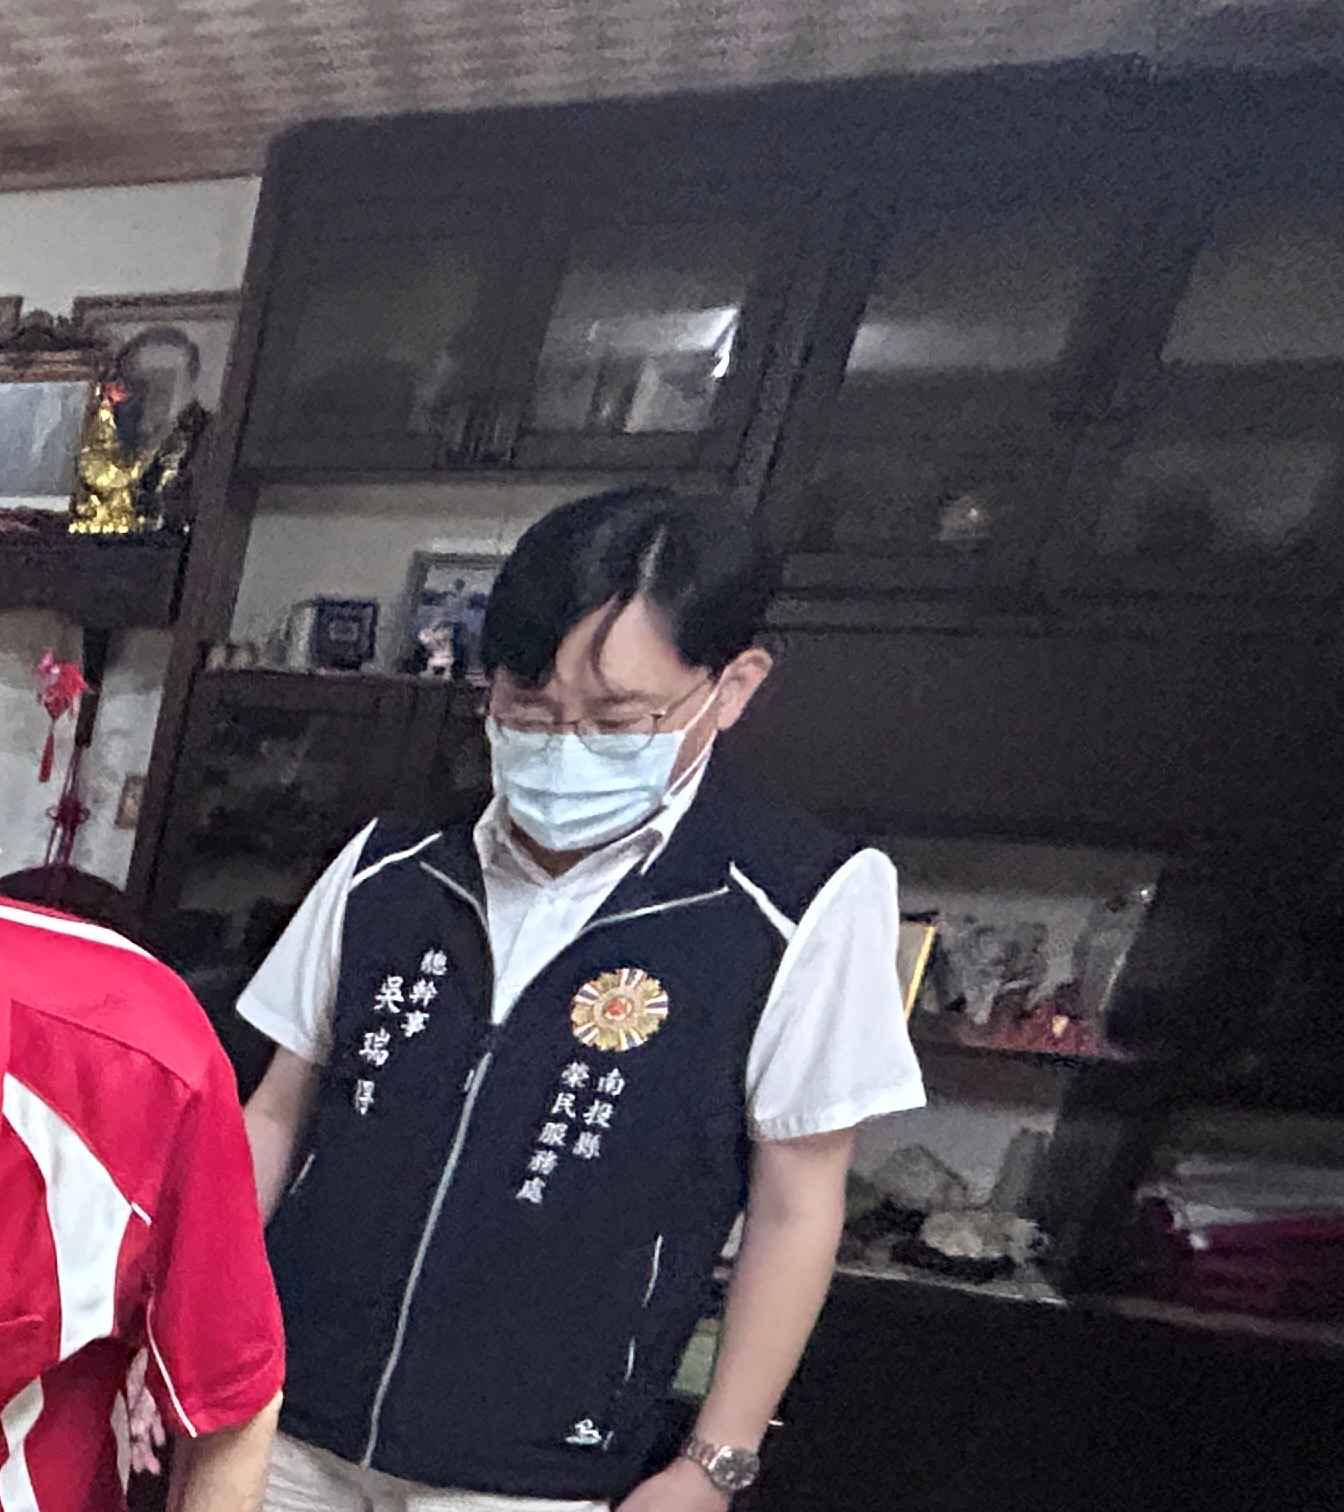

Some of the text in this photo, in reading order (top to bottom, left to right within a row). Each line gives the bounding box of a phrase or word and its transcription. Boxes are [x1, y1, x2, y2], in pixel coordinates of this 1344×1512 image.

[400, 947, 448, 1038] 總幹事
[515, 1060, 591, 1205] 榮民服務處
[571, 1067, 626, 1160] 南投縣
